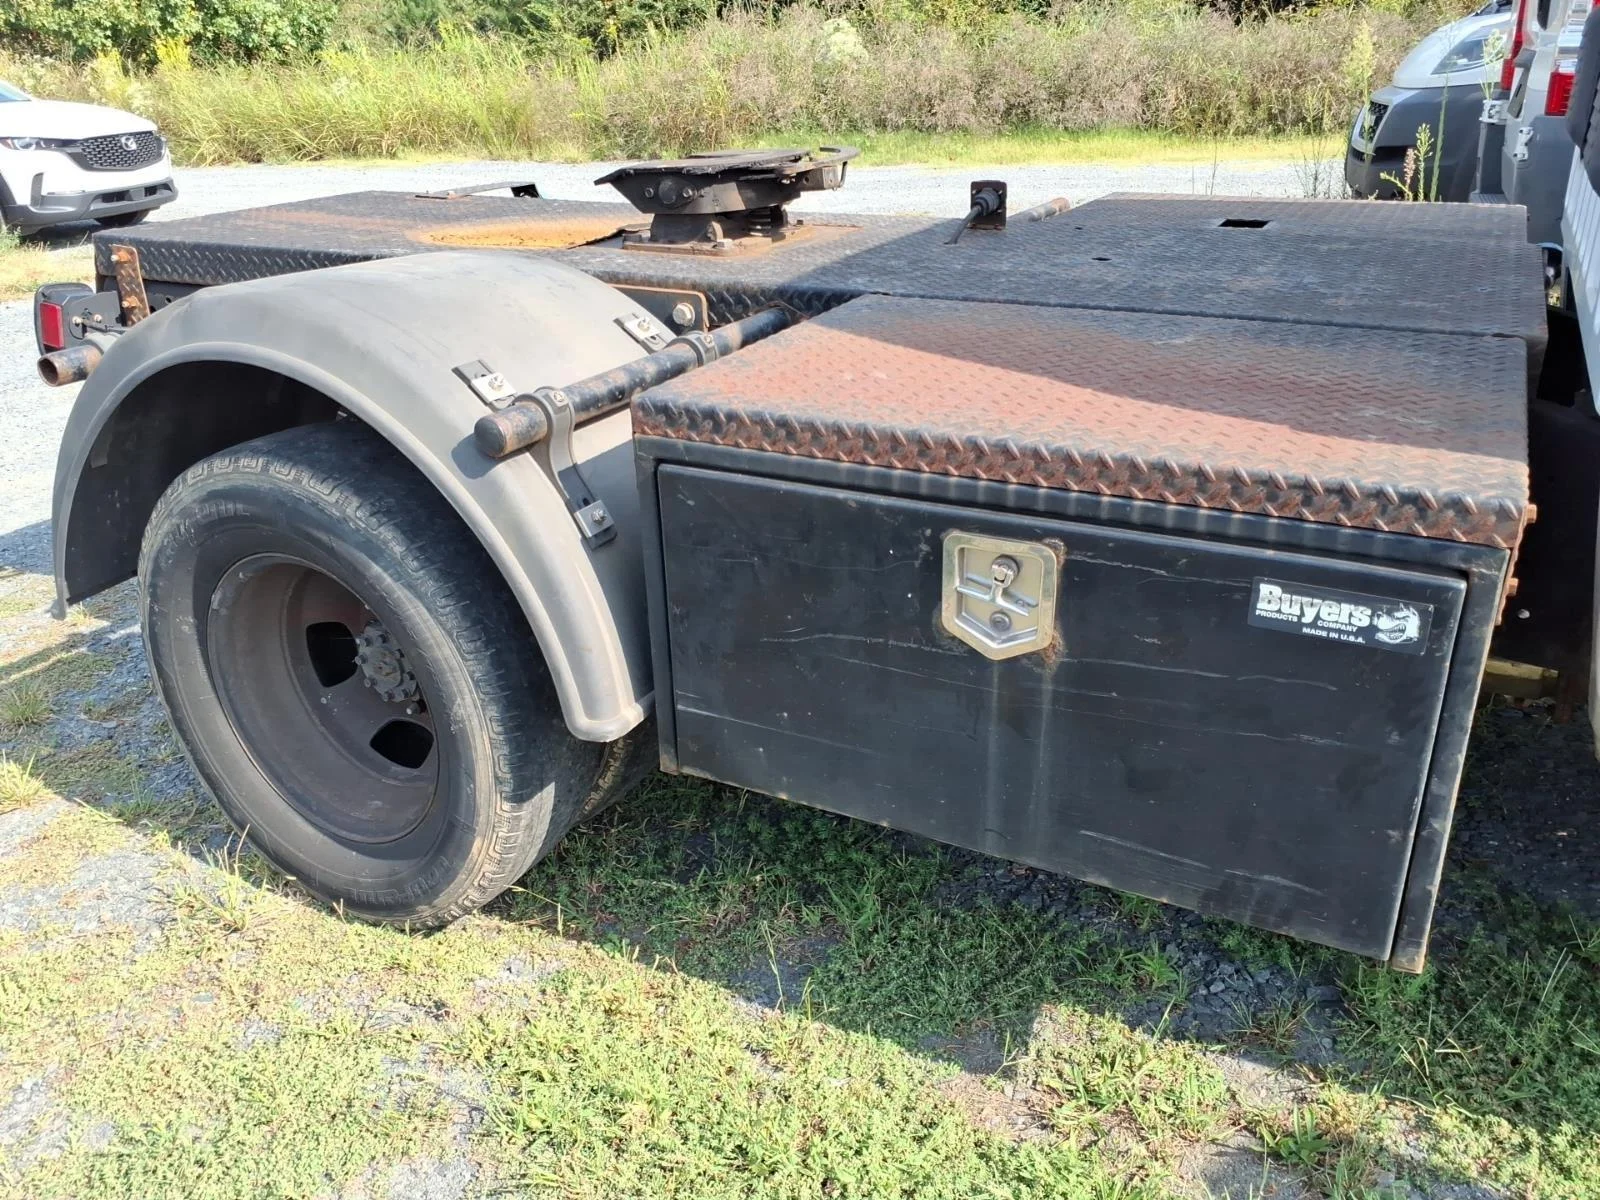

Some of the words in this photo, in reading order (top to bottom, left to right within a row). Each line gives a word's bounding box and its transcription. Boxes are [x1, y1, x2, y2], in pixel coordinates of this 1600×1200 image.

[1256, 583, 1372, 627] Buyers
[1255, 609, 1298, 622] PRODUCTS
[1317, 619, 1358, 633] COMPANY
[1302, 627, 1328, 637] MADE
[1329, 631, 1339, 639] IN
[1340, 634, 1366, 644] U.S.A.
